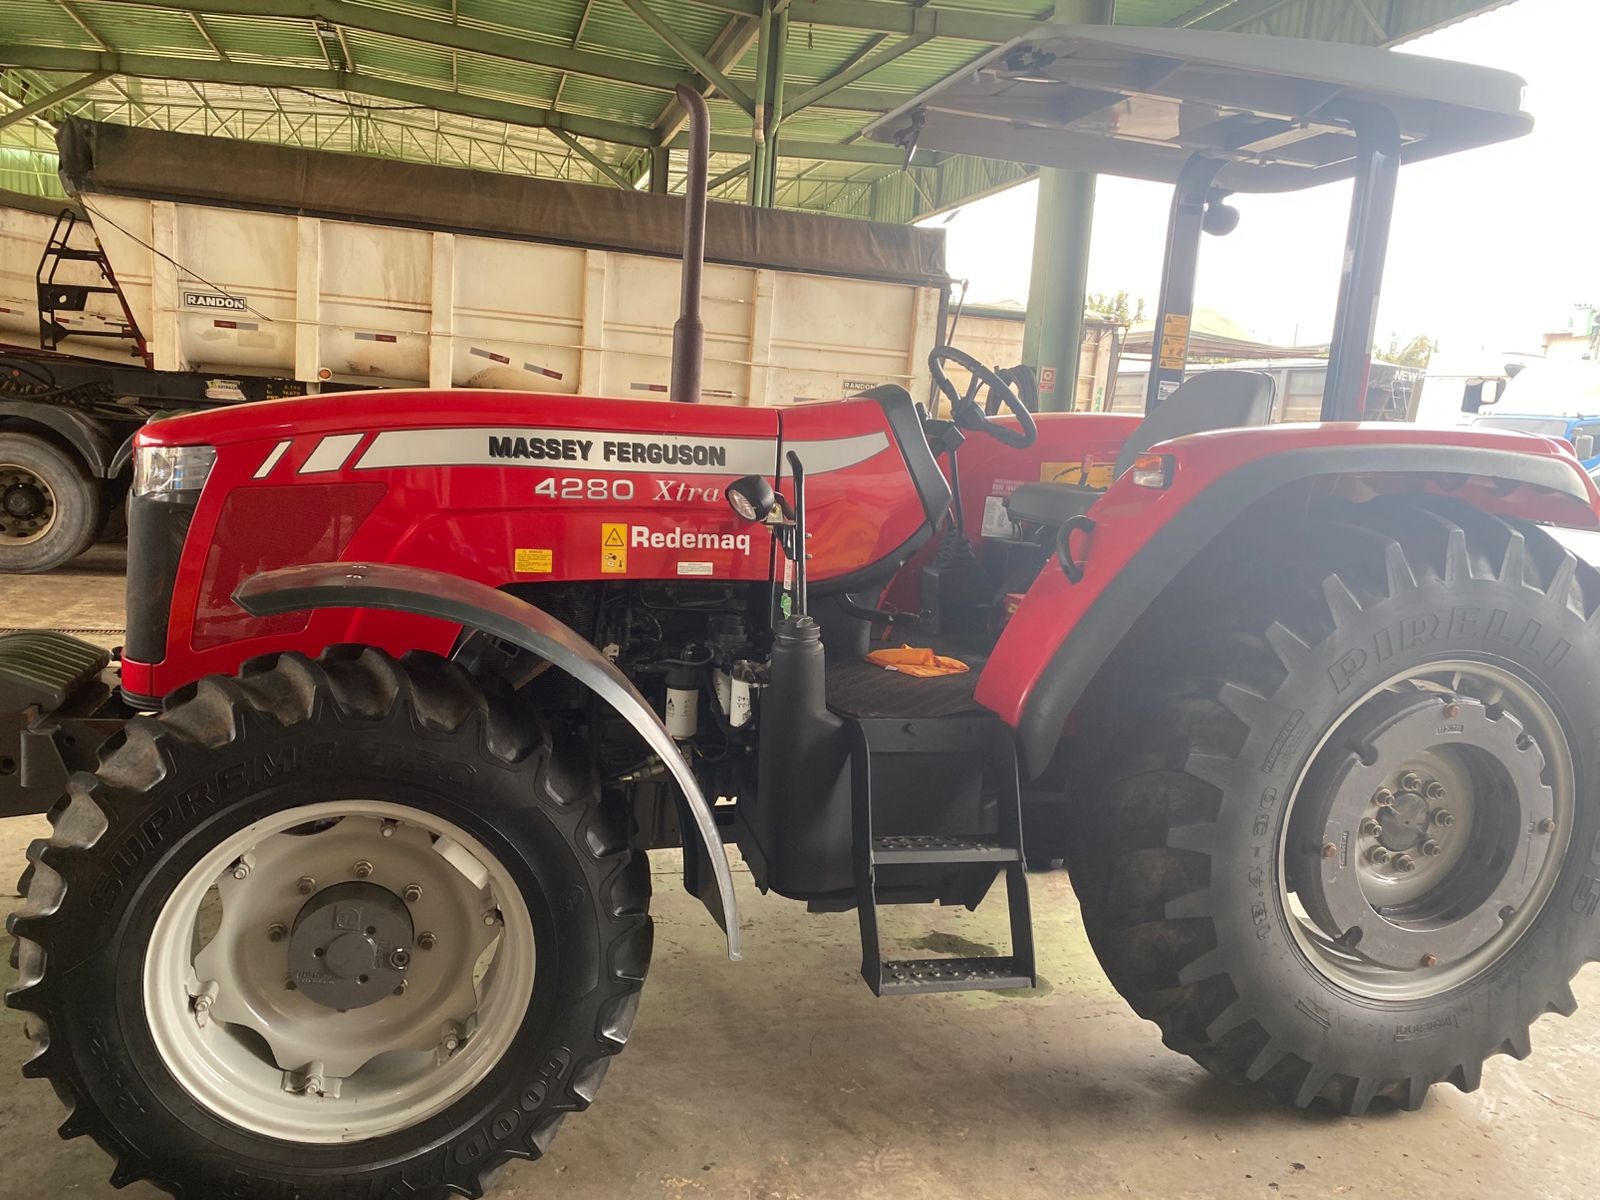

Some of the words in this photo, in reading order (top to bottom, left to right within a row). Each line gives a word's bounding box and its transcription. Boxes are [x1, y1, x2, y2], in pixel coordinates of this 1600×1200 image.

[187, 295, 244, 309] RANDON
[1394, 370, 1418, 384] NEW
[488, 436, 593, 461] MASSEY
[603, 441, 726, 466] FERGUSON
[534, 477, 635, 500] 4280
[652, 479, 720, 503] Xtra
[631, 525, 751, 555] Redemaq
[1327, 606, 1573, 694] PIRELLI
[88, 741, 338, 911] SUPREME
